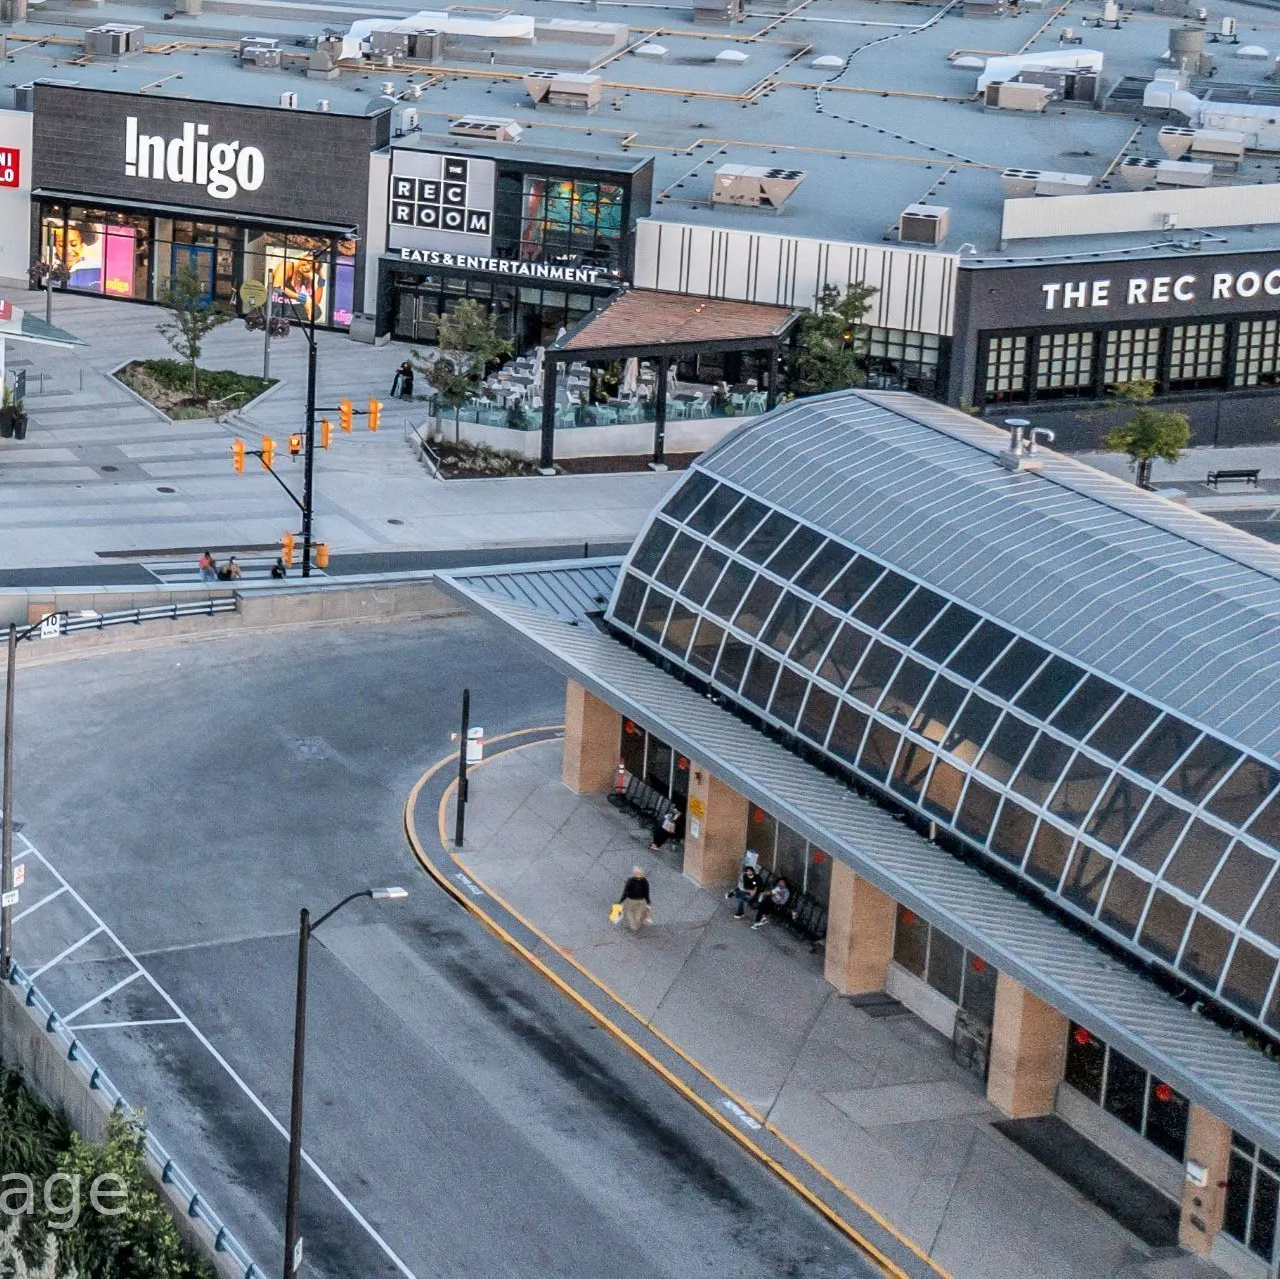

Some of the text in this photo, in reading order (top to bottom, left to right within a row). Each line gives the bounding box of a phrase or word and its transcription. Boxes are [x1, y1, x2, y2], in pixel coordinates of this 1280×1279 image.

[448, 166, 463, 174] THE
[397, 181, 462, 202] REC
[396, 206, 487, 231] ROOM
[401, 247, 440, 264] EATS
[442, 253, 454, 266] &
[456, 254, 599, 283] ENTERTAINMENT
[1042, 280, 1111, 310] THE
[1126, 275, 1197, 305] REC
